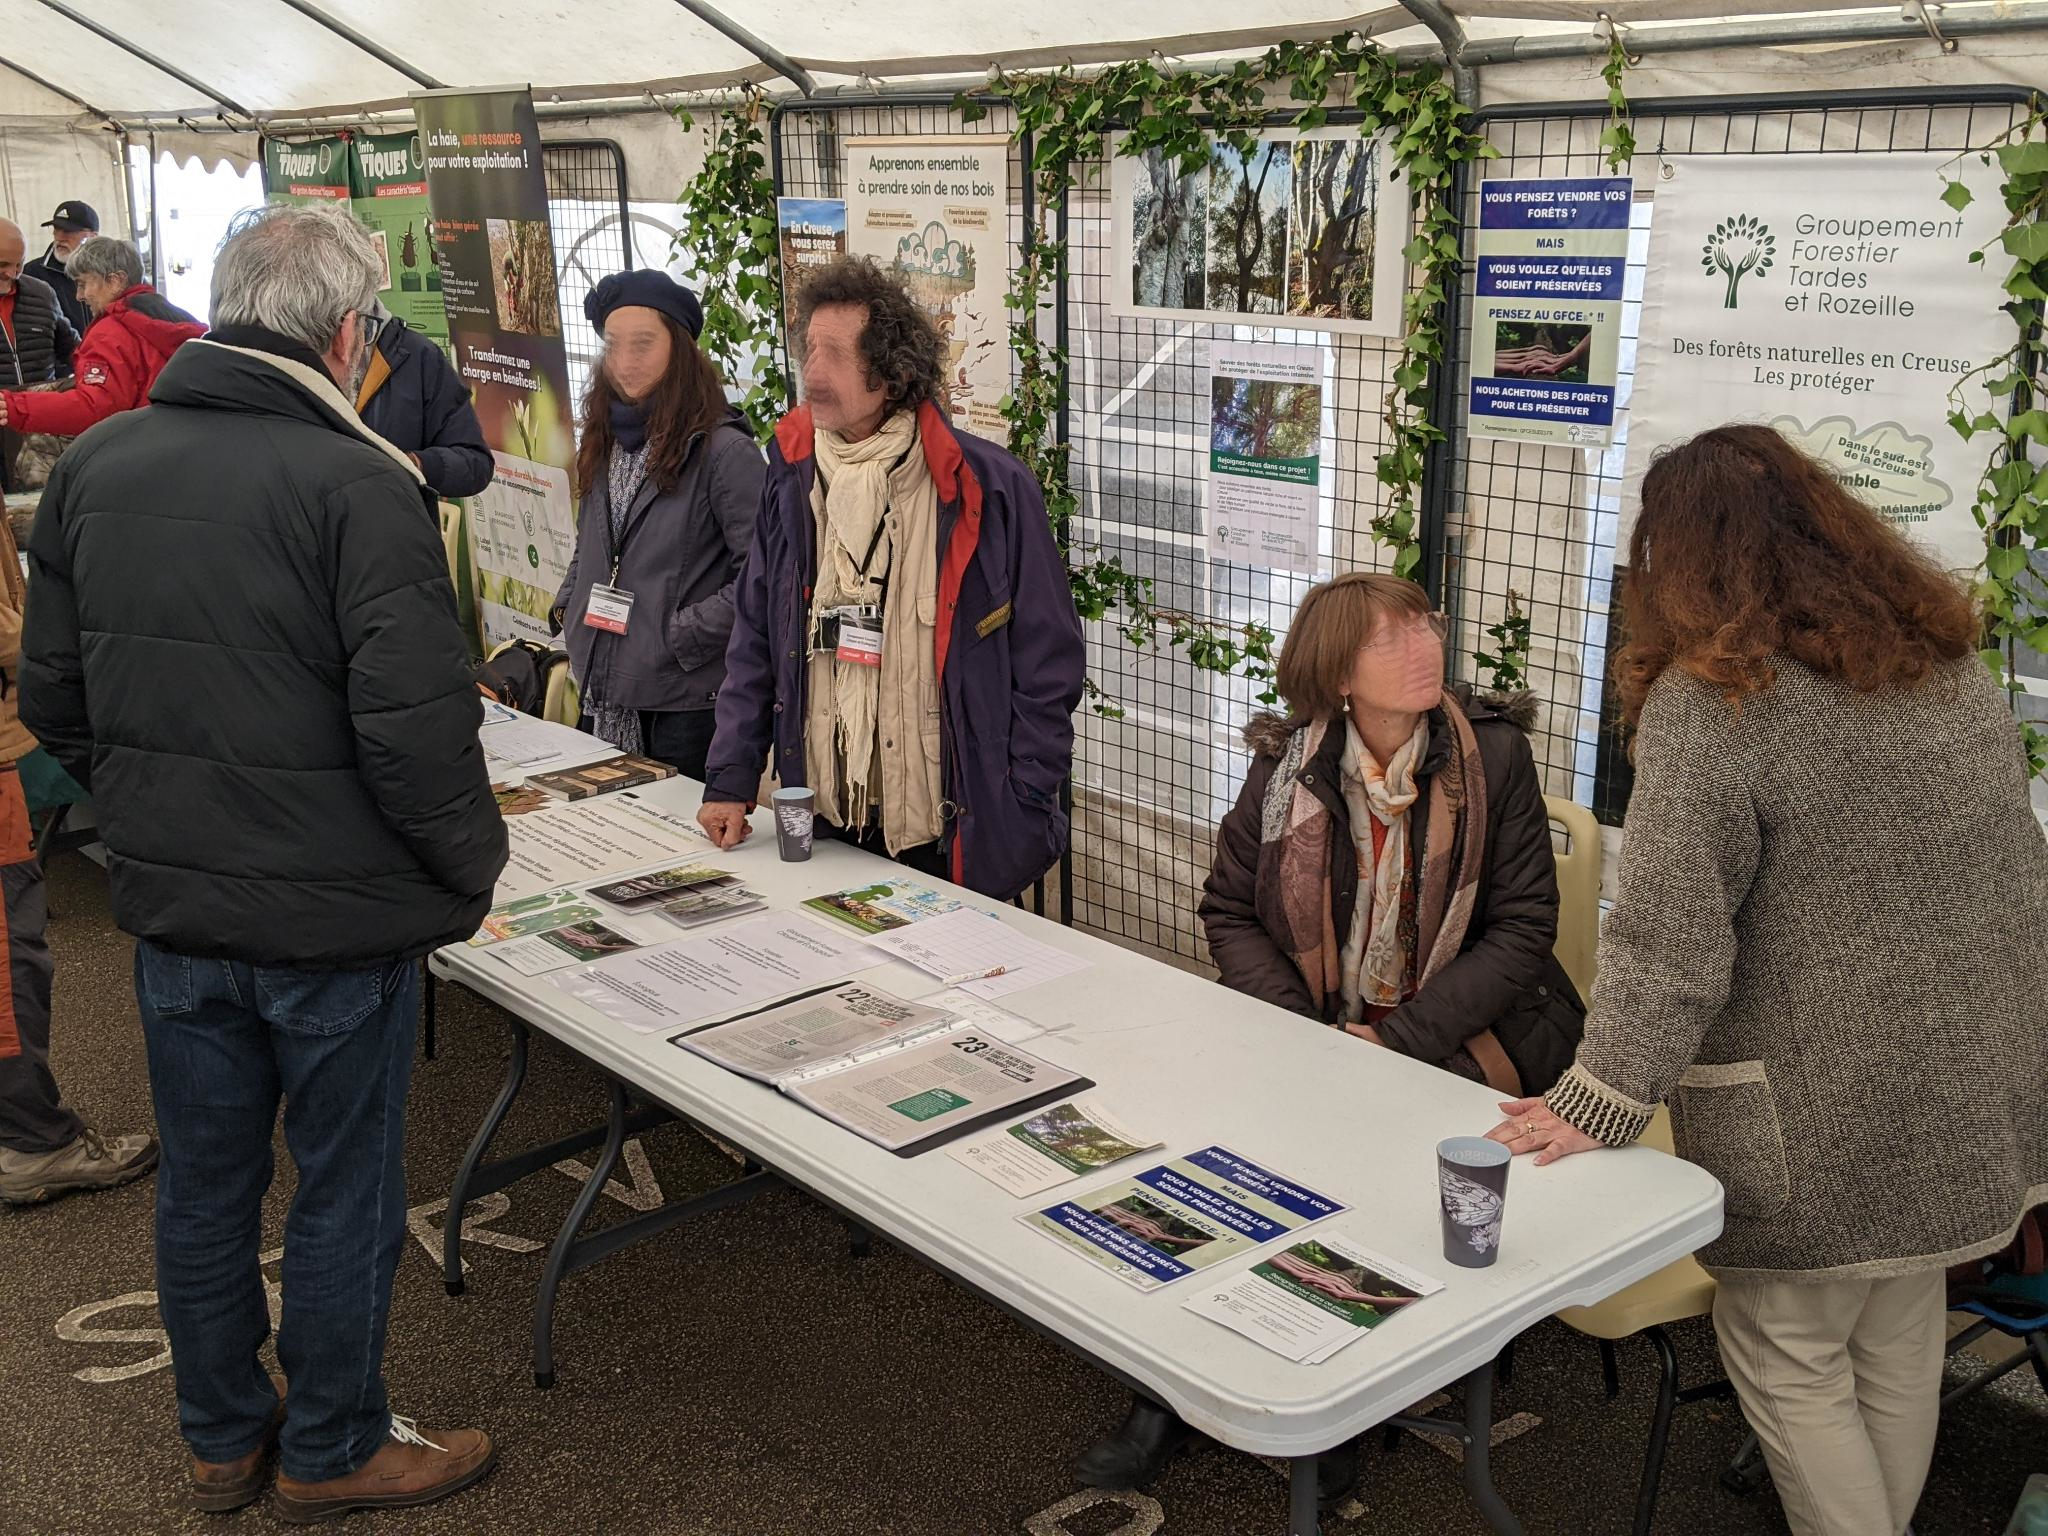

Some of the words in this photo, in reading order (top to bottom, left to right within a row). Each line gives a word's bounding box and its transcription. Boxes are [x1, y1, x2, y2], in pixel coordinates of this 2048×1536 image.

[427, 129, 438, 146] La
[439, 128, 460, 149] haie,
[463, 133, 477, 146] une
[479, 132, 521, 146] ressource
[279, 153, 317, 179] TIQUES
[360, 150, 407, 180] TIQUES
[428, 156, 447, 173] pour
[448, 153, 470, 168] votre
[472, 149, 521, 174] exploitation
[523, 148, 529, 169] !
[869, 155, 924, 173] Apprenons
[928, 155, 980, 171] ensemble
[858, 178, 865, 194] à
[868, 179, 908, 196] prendre
[911, 180, 931, 195] soin
[934, 179, 948, 196] de
[951, 184, 969, 196] nos
[972, 180, 995, 197] bois
[1486, 192, 1512, 203] VOUS
[1514, 191, 1554, 203] PENSEZ
[1557, 191, 1600, 202] VENDRE
[1604, 190, 1626, 201] VOS
[1527, 206, 1568, 218] FORÊTS
[1571, 208, 1577, 218] ?
[790, 220, 801, 234] En
[802, 221, 835, 238] Creuse,
[1795, 213, 1964, 241] Groupement
[791, 237, 812, 250] vous
[812, 239, 836, 251] serez
[1536, 238, 1564, 248] MAIS
[1791, 240, 1899, 265] Forestier
[796, 250, 826, 267] surpris
[1489, 264, 1516, 274] VOUS
[1518, 264, 1558, 275] VOULEZ
[1561, 265, 1612, 276] QU'ELLES
[1789, 265, 1868, 289] Tardes
[1495, 280, 1532, 290] SOIENT
[1534, 278, 1602, 292] PRÉSERVÉES
[1489, 308, 1532, 320] PENSEZ
[1534, 310, 1550, 320] AU
[1784, 292, 1809, 312] et
[1817, 293, 1915, 318] Rozeille
[468, 345, 516, 367] Transformez
[516, 357, 531, 370] une
[1672, 337, 1704, 356] Des
[1708, 339, 1762, 360] forêts
[1767, 344, 1865, 368] naturelles
[1870, 354, 1895, 369] en
[1901, 352, 1972, 375] Creuse
[462, 362, 491, 384] charge
[493, 371, 502, 383] en
[502, 368, 537, 390] bénéfices
[1753, 366, 1785, 386] Les
[1789, 368, 1875, 396] protéger
[1475, 385, 1500, 396] NOUS
[1502, 387, 1550, 399] ACHETONS
[1552, 391, 1569, 401] DES
[1571, 389, 1609, 404] FORÊTS
[1491, 400, 1516, 411] POUR
[1517, 402, 1533, 412] LES
[1535, 402, 1590, 416] PRÉSERVER
[1838, 437, 1868, 452] Dans
[1869, 446, 1880, 456] le
[1882, 451, 1928, 470] sud-est
[1844, 449, 1858, 460] de
[1860, 453, 1871, 464] la
[1873, 457, 1915, 477] Creuse
[1217, 456, 1262, 468] Rejoignez-nous
[1263, 462, 1278, 470] dans
[1287, 465, 1307, 474] projet
[1881, 502, 1943, 514] Mélangée
[836, 988, 871, 1003] 22
[951, 1036, 989, 1054] 23
[1206, 1150, 1232, 1165] VOUS
[1231, 1162, 1270, 1183] PENSEZ
[1269, 1180, 1309, 1202] VENDRE
[1309, 1199, 1332, 1212] VOS
[1231, 1172, 1271, 1193] FORÊTS
[1130, 1187, 1173, 1210] PENSEZ
[1171, 1207, 1189, 1218] AU
[1161, 1172, 1189, 1188] VOUS
[1188, 1185, 1228, 1207] VOULEZ
[1225, 1205, 1273, 1231] QU'ELLES
[1219, 1185, 1249, 1201] MAIS
[1156, 1180, 1194, 1201] SOIENT
[1191, 1196, 1254, 1232] PRÉSERVÉES
[1061, 1205, 1087, 1221] NOUS
[1085, 1217, 1131, 1246] ACHETONS
[1129, 1242, 1149, 1256] DES
[1147, 1252, 1183, 1274] FORÊTS
[1064, 1217, 1090, 1234] POUR
[1088, 1231, 1107, 1243] LES
[1104, 1239, 1156, 1270] PRÉSERVER
